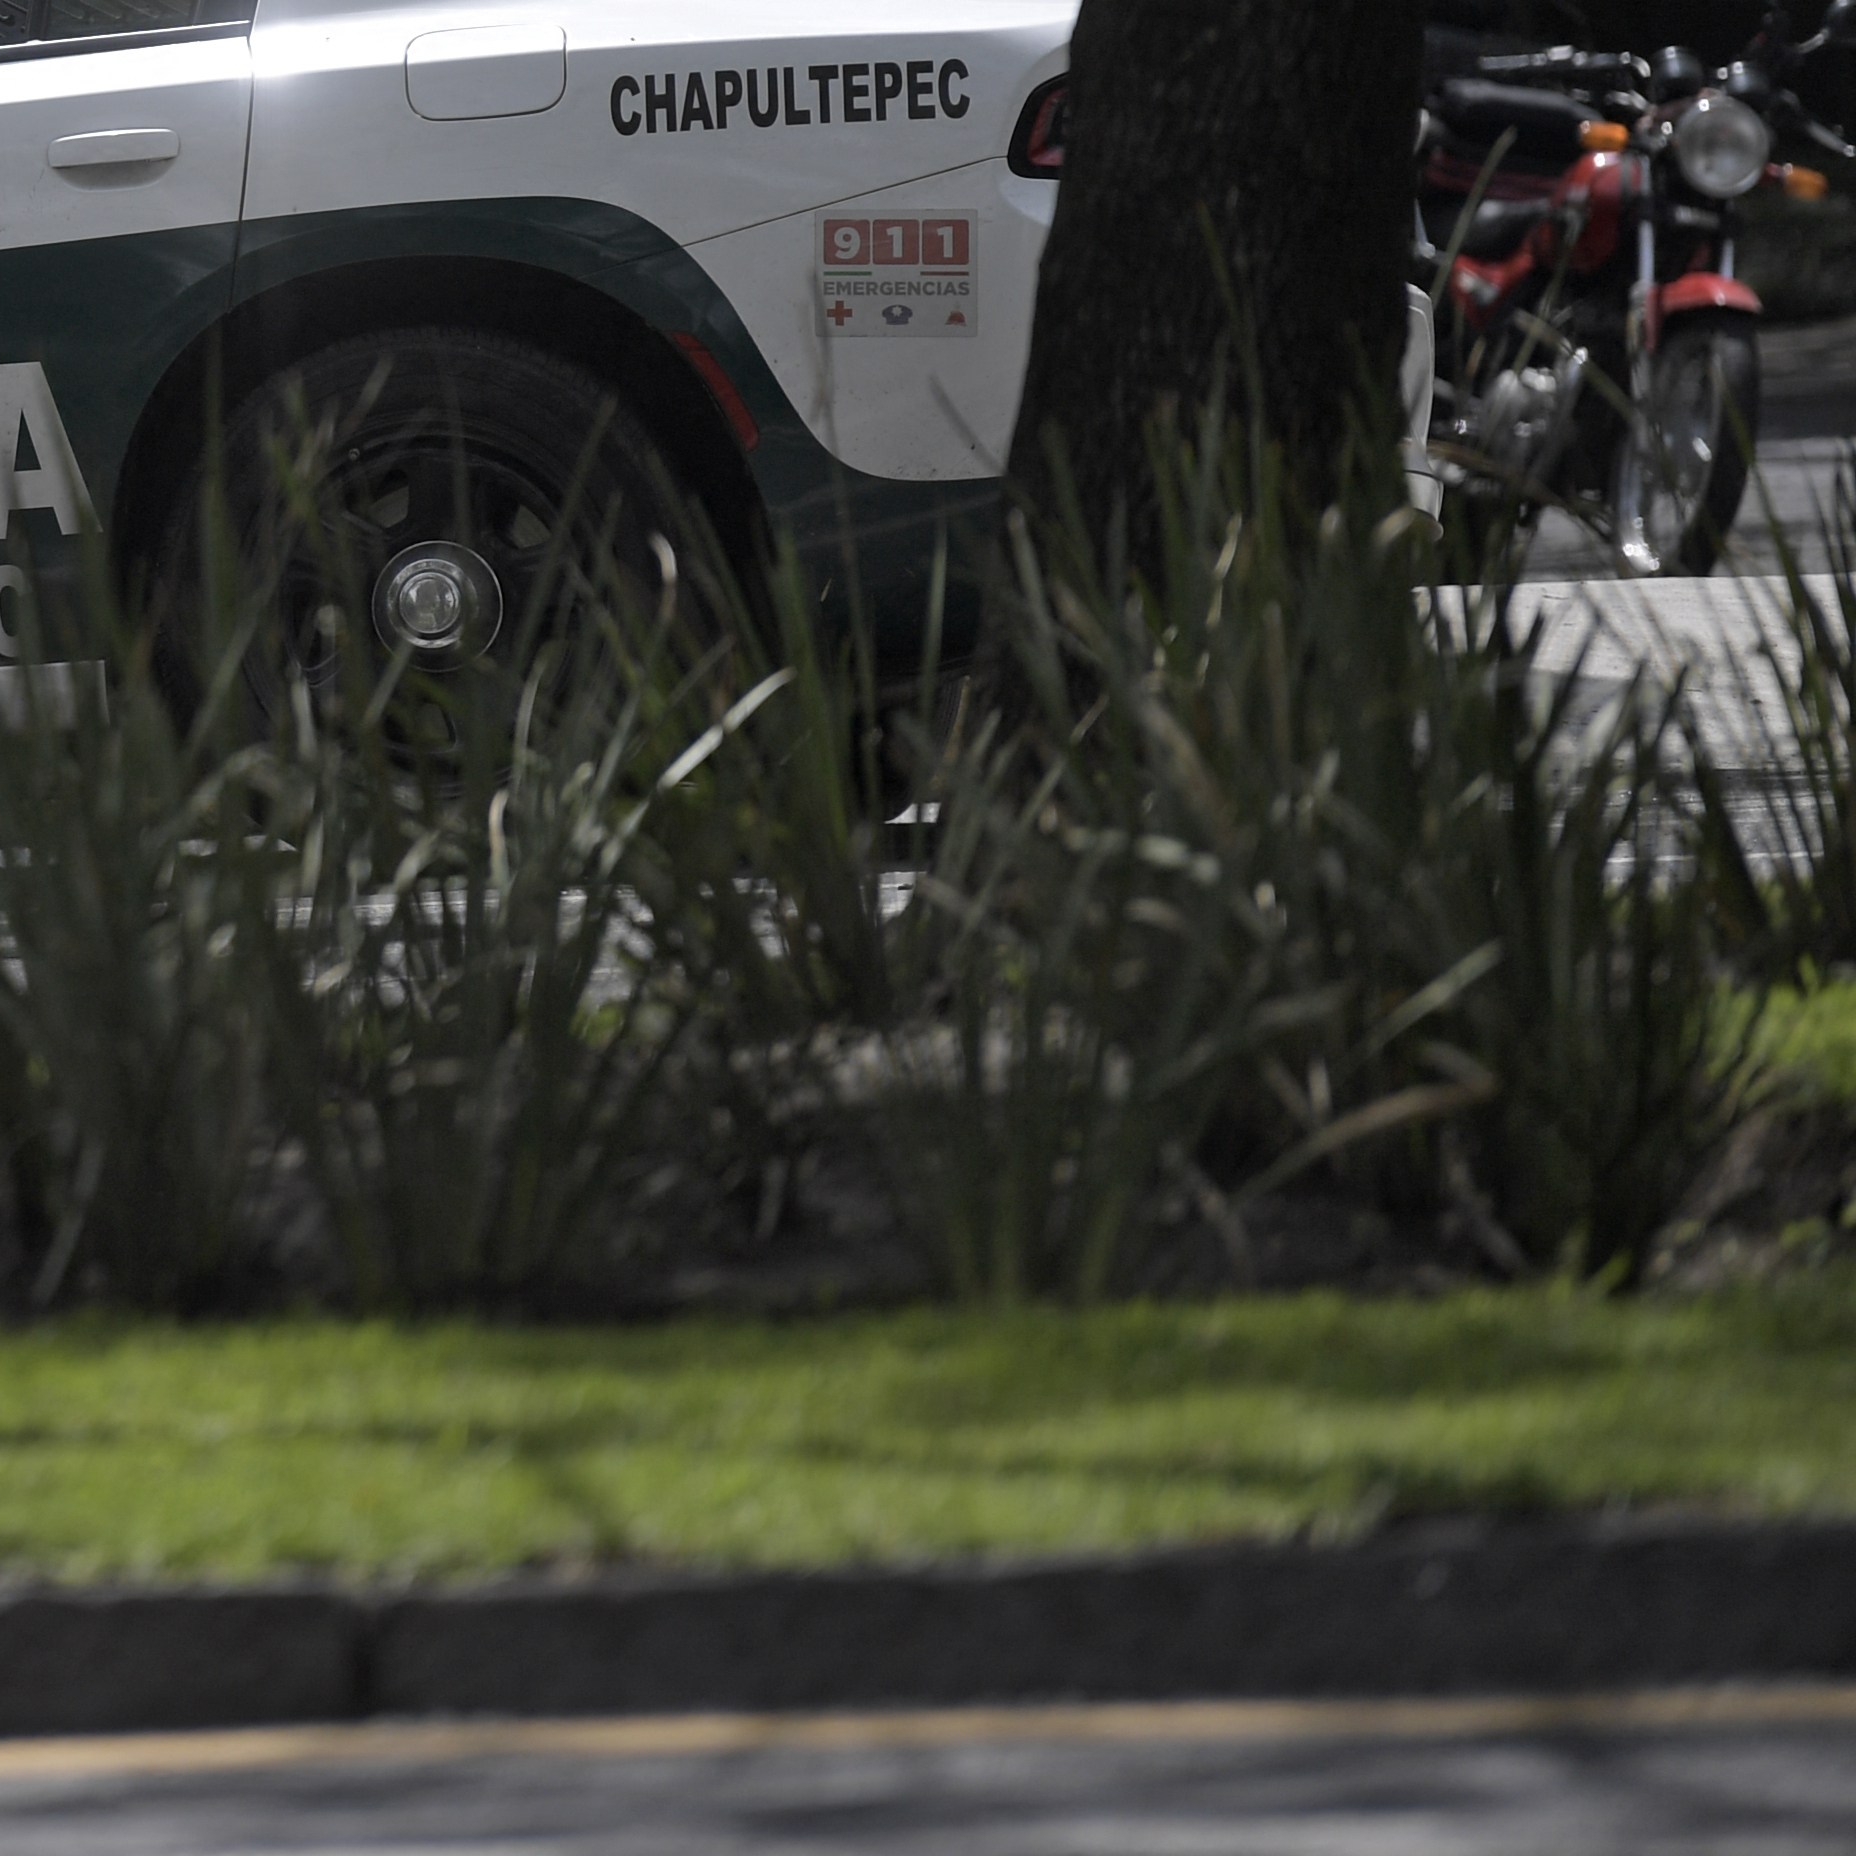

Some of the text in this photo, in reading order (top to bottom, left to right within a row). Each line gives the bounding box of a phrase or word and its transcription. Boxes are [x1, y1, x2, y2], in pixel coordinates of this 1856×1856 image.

[609, 58, 971, 136] CHAPULTEPEC
[833, 225, 954, 260] 911
[823, 281, 970, 296] EMERGENCIAS
